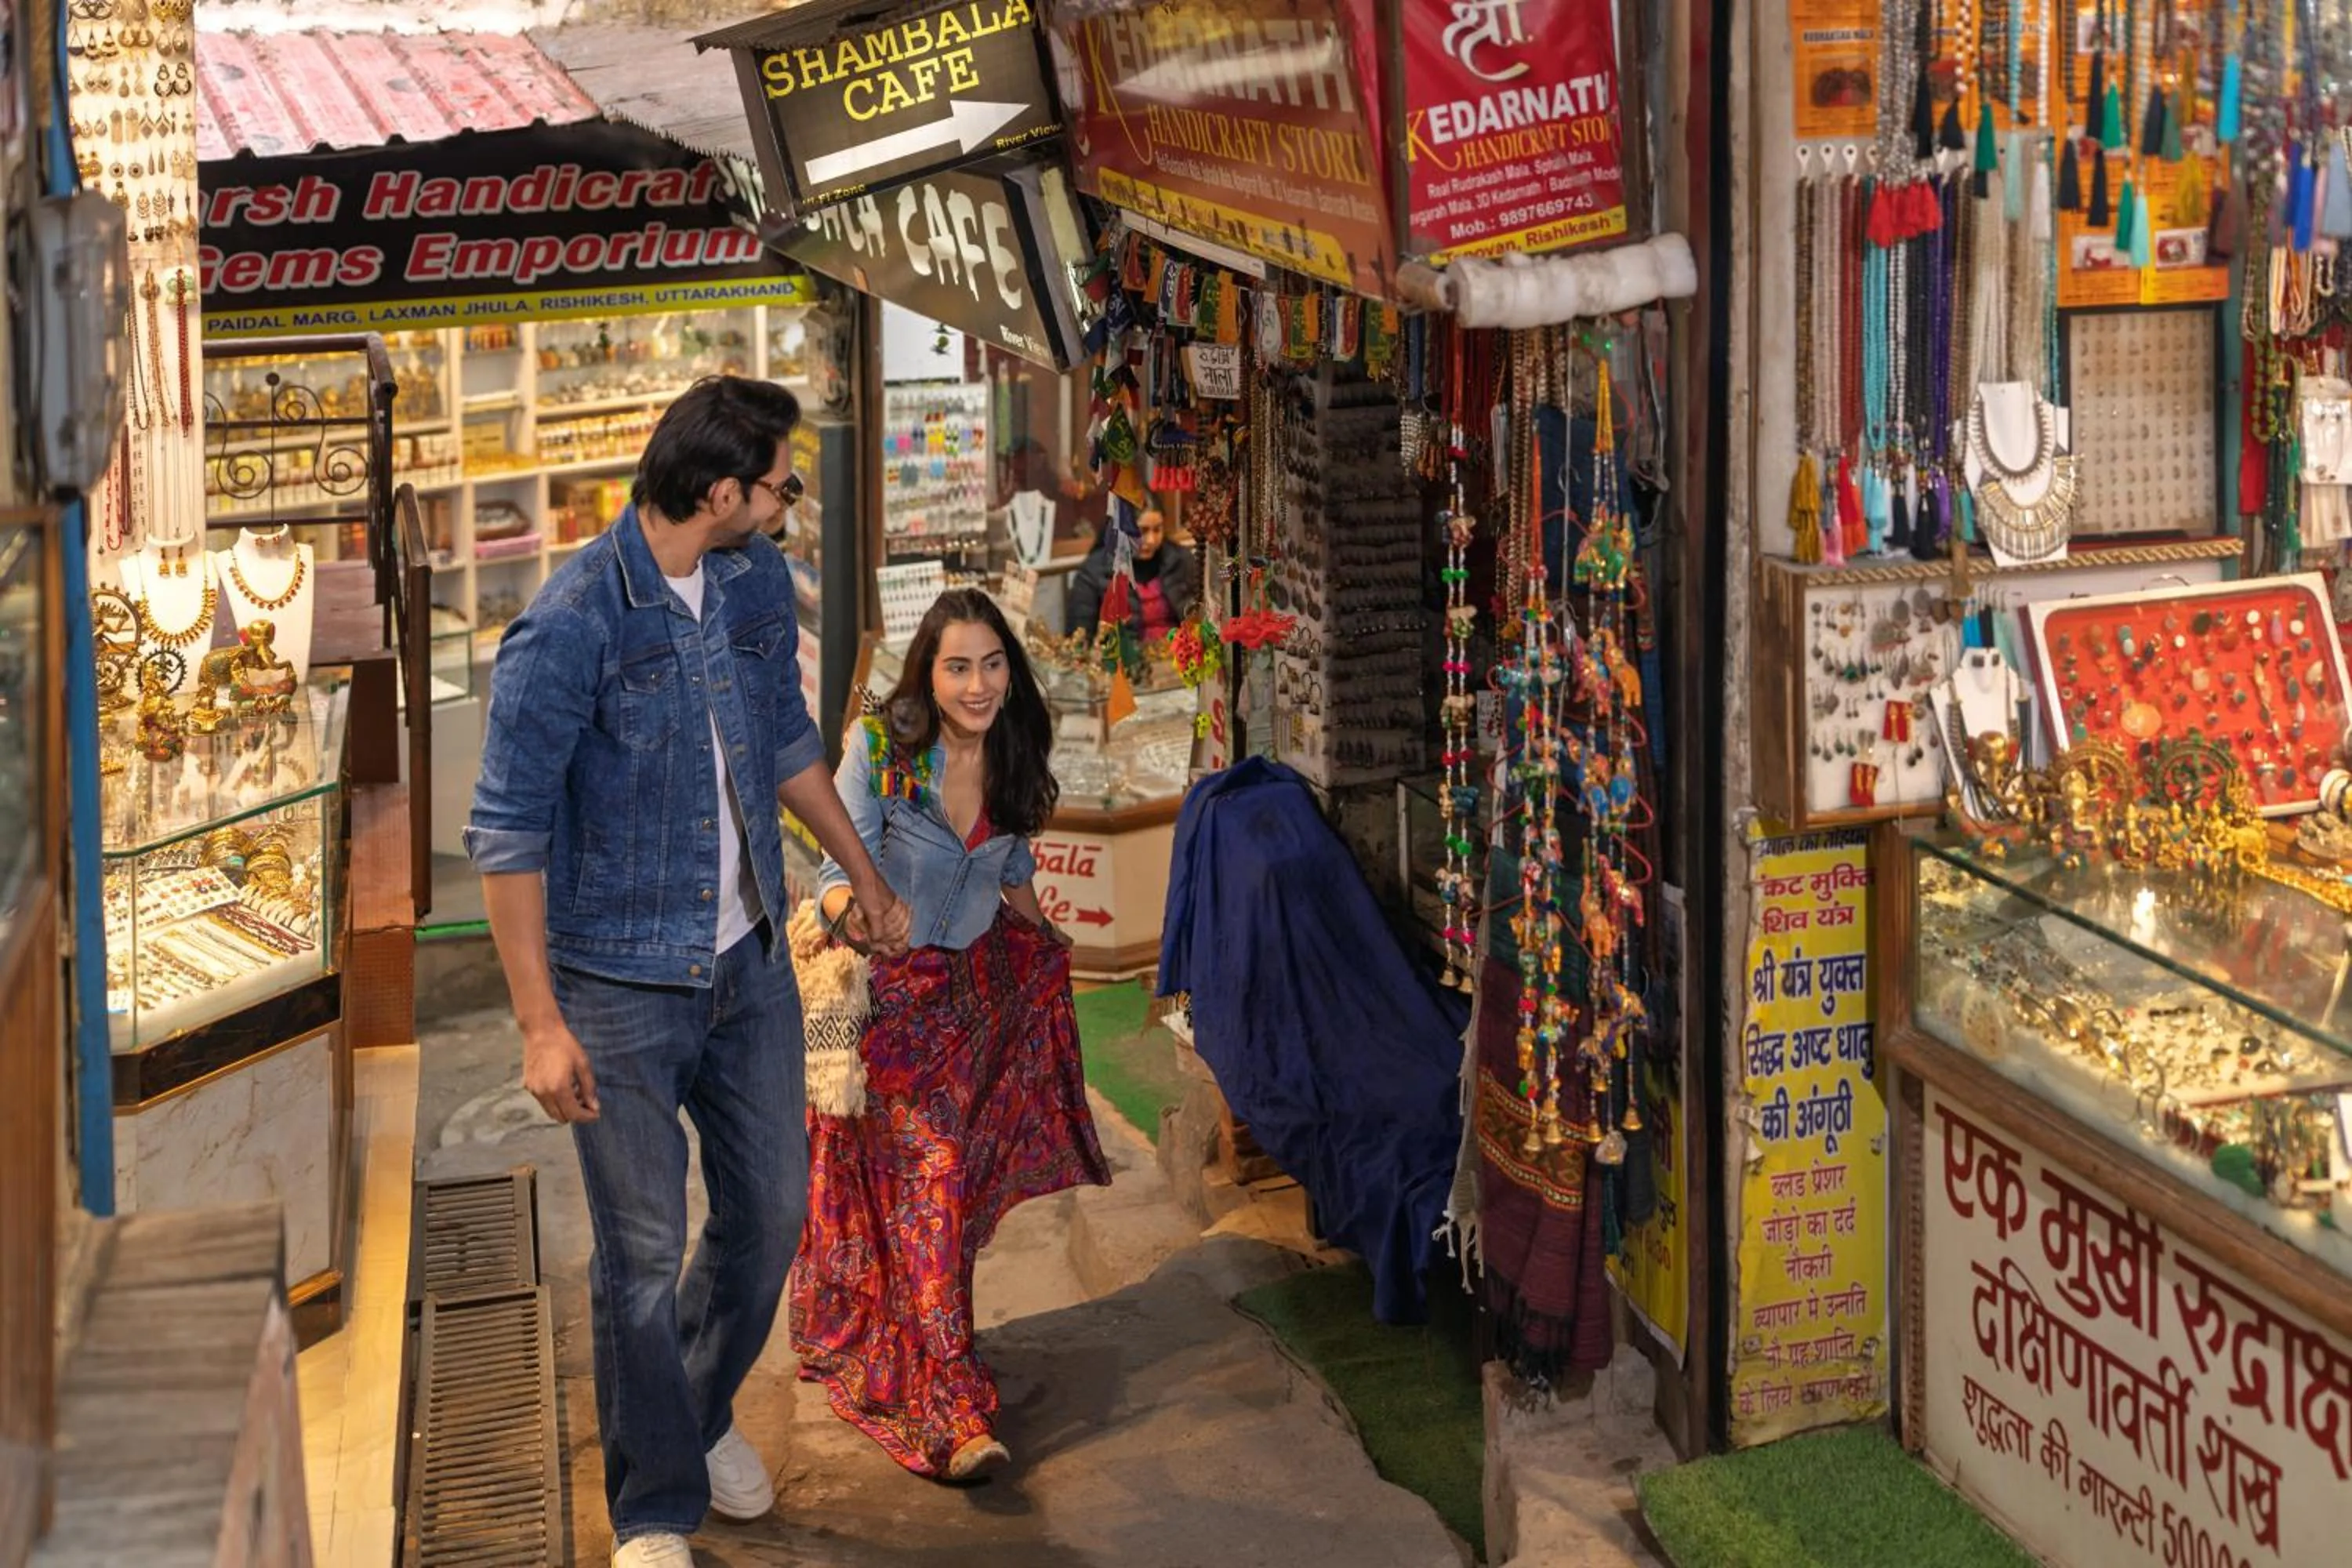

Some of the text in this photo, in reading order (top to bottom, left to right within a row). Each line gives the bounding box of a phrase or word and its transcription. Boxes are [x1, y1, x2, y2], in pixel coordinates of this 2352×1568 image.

[760, 0, 1033, 100] SHAMBALA
[843, 46, 979, 122] CAFE
[1147, 103, 1272, 168] HANDICRAFT
[1462, 122, 1567, 168] HANDICRAFT
[198, 174, 341, 227] rsh
[362, 155, 726, 221] Handicraf
[404, 221, 763, 285] Emporium
[897, 183, 1022, 310] CAFE
[1525, 216, 1610, 247] Rishikesh
[207, 281, 797, 333] PAIDAL MARG, LAXMAN JHULA, RISHIKESH, UTTARAKHAND
[1762, 900, 1856, 935] शिव यंत्र
[1753, 946, 1866, 1016] श्री यंत्र युक्त
[1746, 1022, 1875, 1081] सिद्ध अष्ट धातु
[1760, 1077, 1854, 1155] की अंगूठी
[1805, 1211, 1829, 1236] का
[1832, 1196, 1857, 1235] दर्द
[1934, 1101, 2028, 1242] एक
[2040, 1167, 2165, 1341] मुखी
[1753, 1300, 1802, 1330] व्यापार
[1823, 1281, 1867, 1319] उन्नति
[1962, 1374, 2034, 1465] शुद्धता
[2039, 1417, 2071, 1491] की
[2197, 1414, 2283, 1559] शंख
